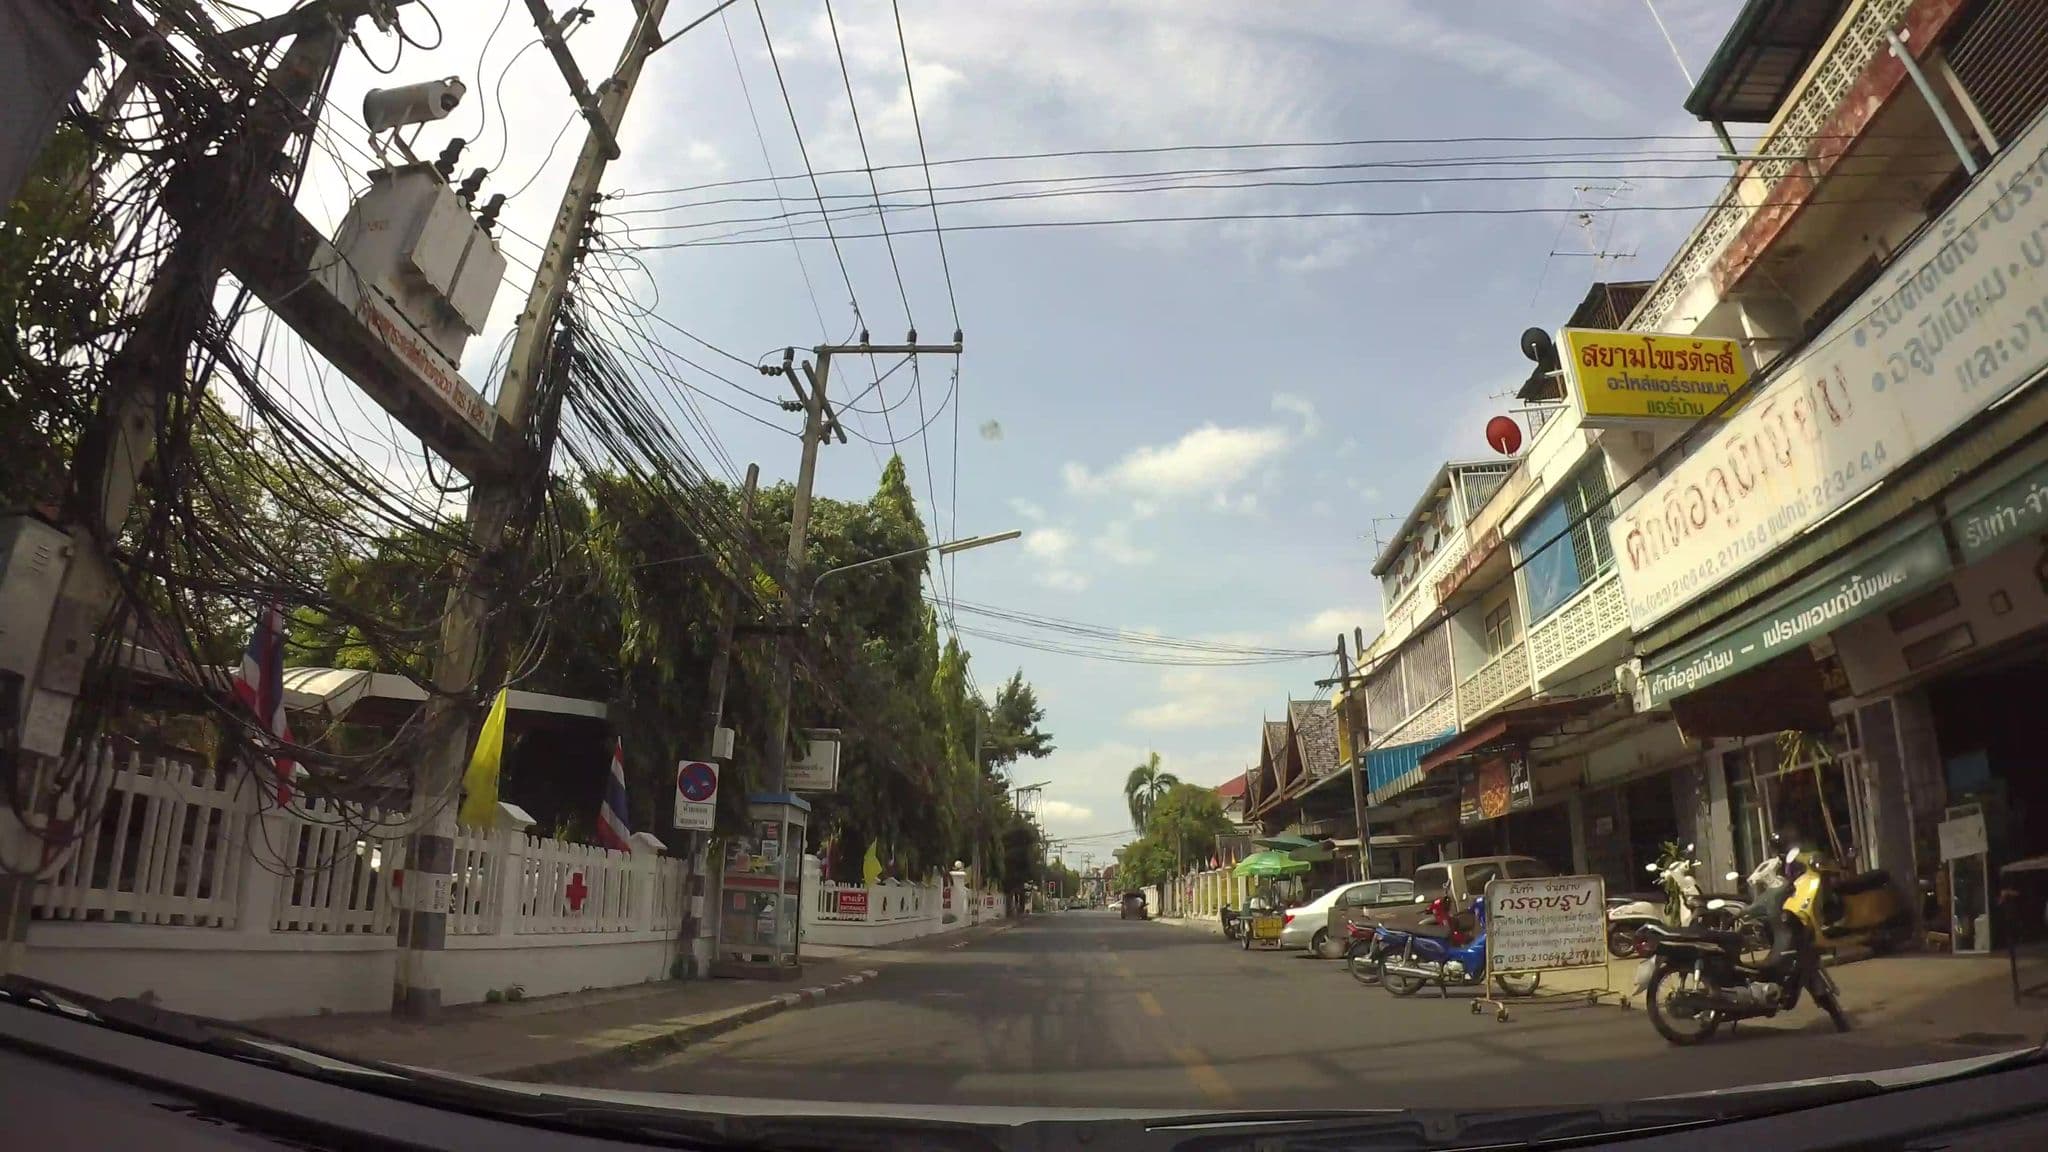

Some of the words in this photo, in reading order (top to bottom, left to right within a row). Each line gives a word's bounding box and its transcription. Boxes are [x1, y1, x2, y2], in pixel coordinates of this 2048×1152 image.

[1646, 397, 1705, 416] แอร์บ้าน
[1500, 890, 1591, 912] กรอบรูป
